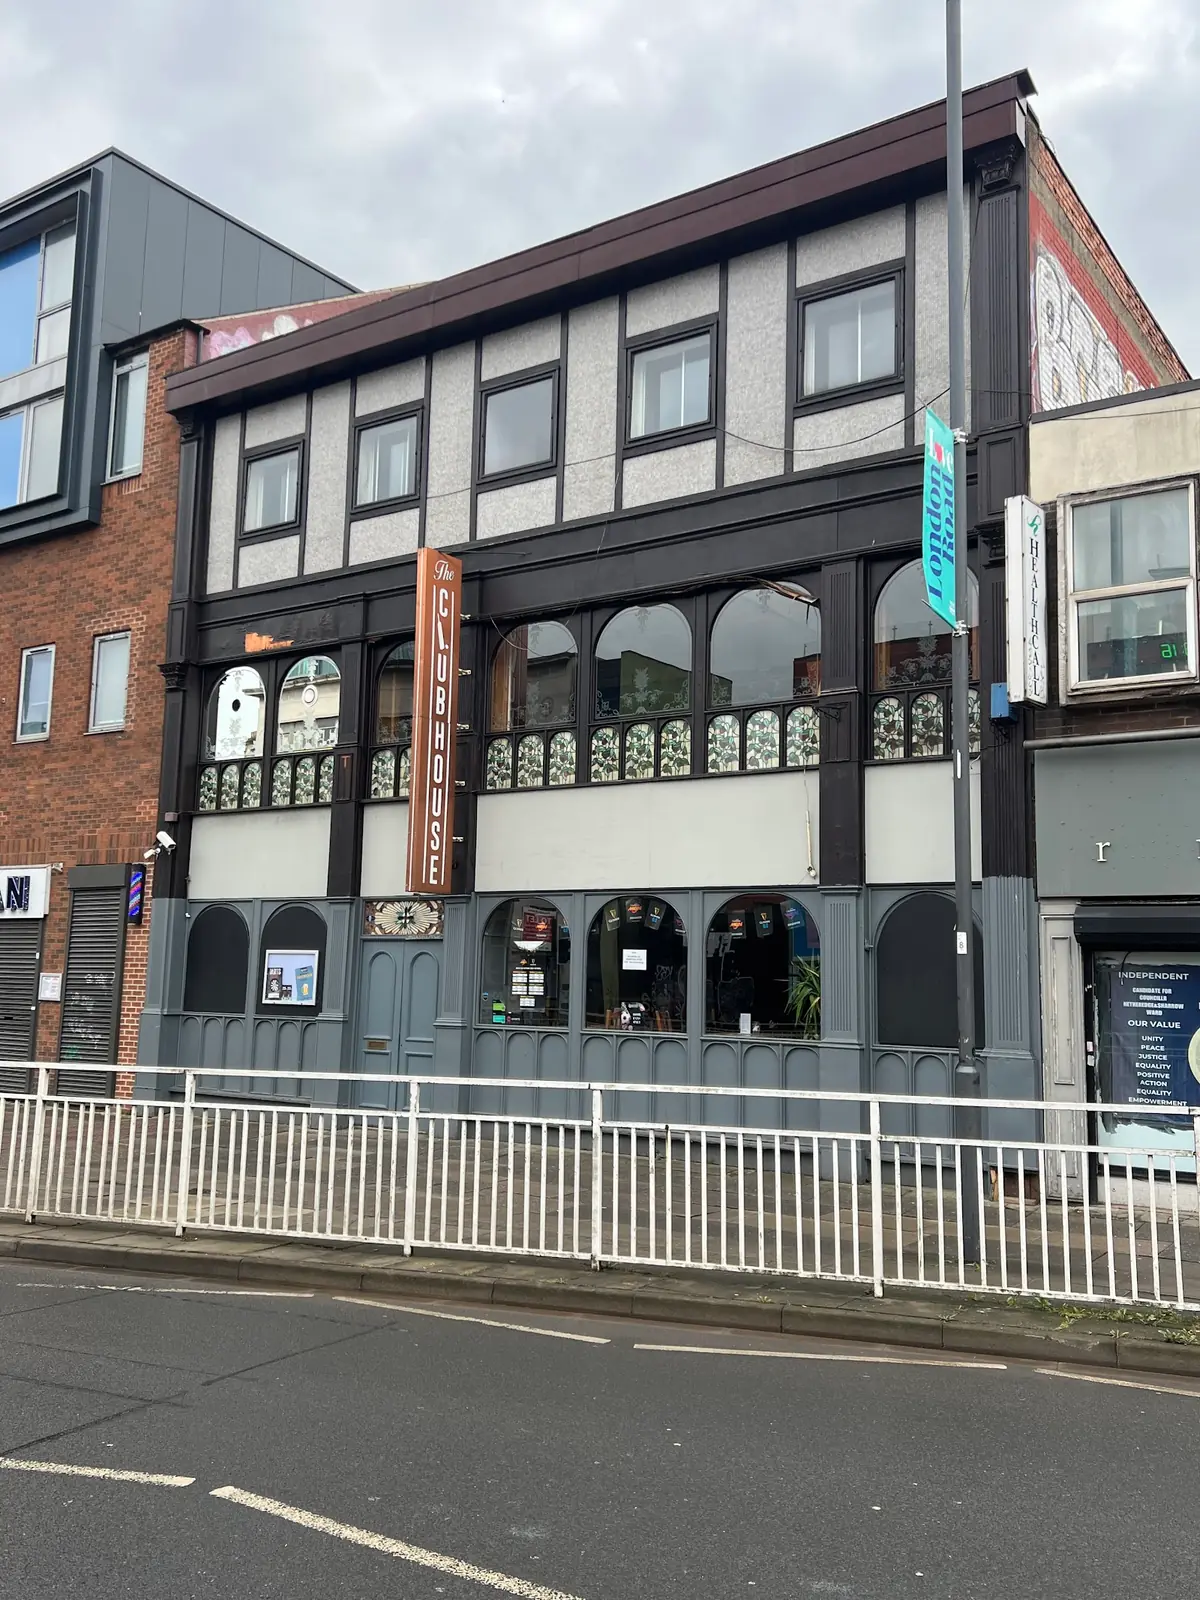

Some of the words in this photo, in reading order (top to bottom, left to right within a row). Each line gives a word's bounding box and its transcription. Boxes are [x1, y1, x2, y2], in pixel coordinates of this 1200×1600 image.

[942, 471, 954, 565] Road
[926, 464, 943, 600] London
[433, 559, 455, 582] The
[1029, 537, 1040, 697] HEALTHCALL
[429, 587, 450, 885] CLUBHOUSE
[1118, 971, 1189, 980] INDEPENDENT
[1127, 1020, 1148, 1028] OUR
[1150, 1021, 1181, 1029] VALUE
[1135, 1062, 1171, 1070] EQUALITY
[1137, 1071, 1170, 1079] POSITIVE
[1136, 1088, 1172, 1096] EQUALITY
[1128, 1096, 1187, 1107] EMPOWERMENT
